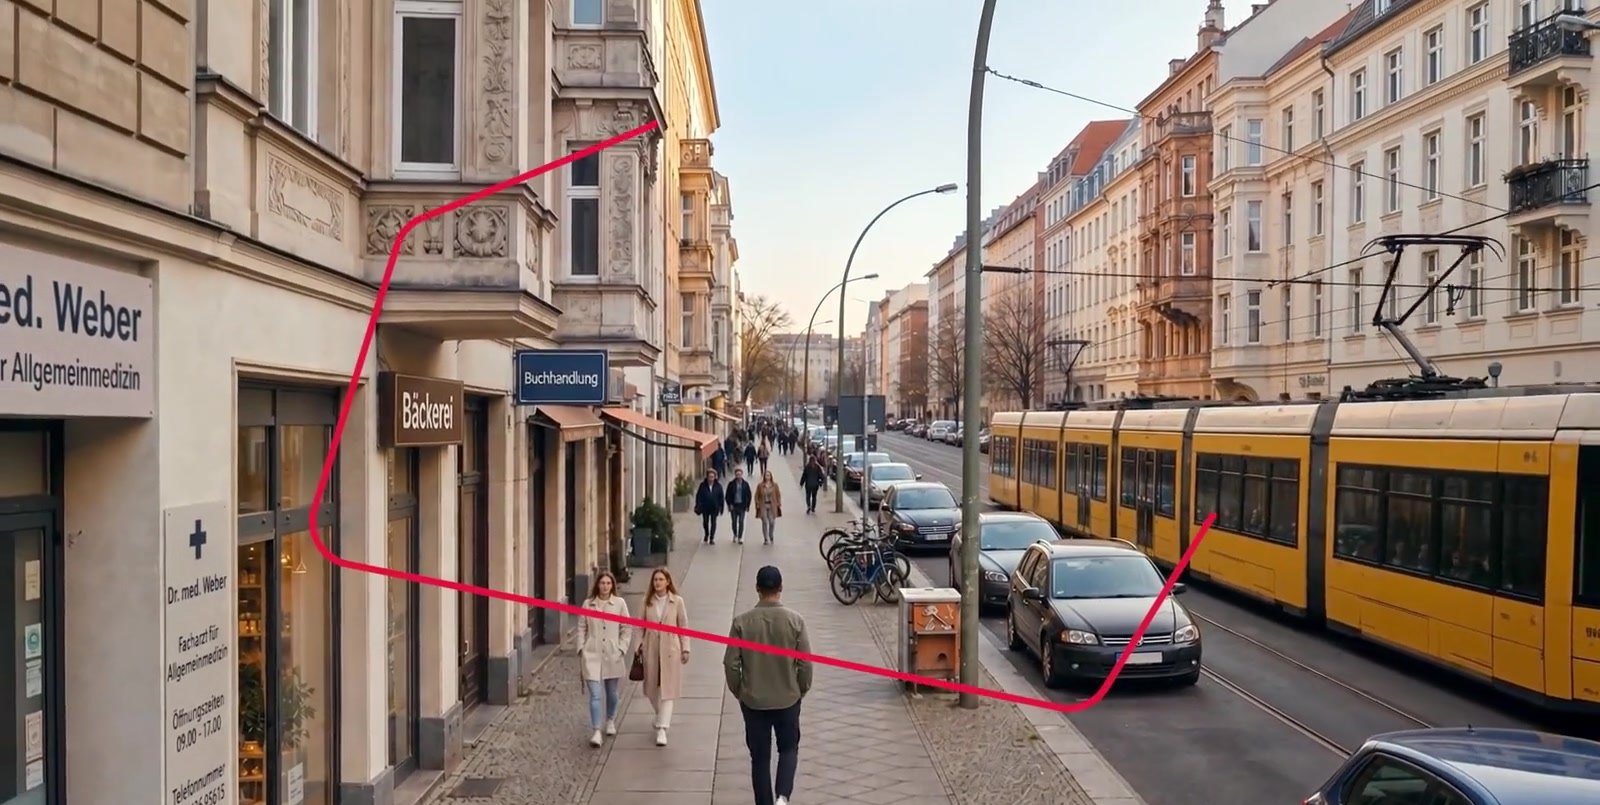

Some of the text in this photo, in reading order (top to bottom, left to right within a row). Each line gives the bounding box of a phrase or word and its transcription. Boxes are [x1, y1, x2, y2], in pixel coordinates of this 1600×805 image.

[53, 280, 142, 342] Weber
[11, 351, 140, 391] Allgemeinmedizin
[524, 371, 599, 388] Buchhandlung
[402, 391, 454, 430] Bäckerei
[167, 573, 227, 605] Dr. med. Weber
[178, 624, 219, 653] Facharzt für
[167, 643, 228, 682] Allgemeinmedizin
[172, 694, 225, 730] Öffnungszeiten
[176, 727, 197, 752] 09.00
[203, 715, 222, 739] 17.00
[172, 763, 226, 805] Telefonnummer
